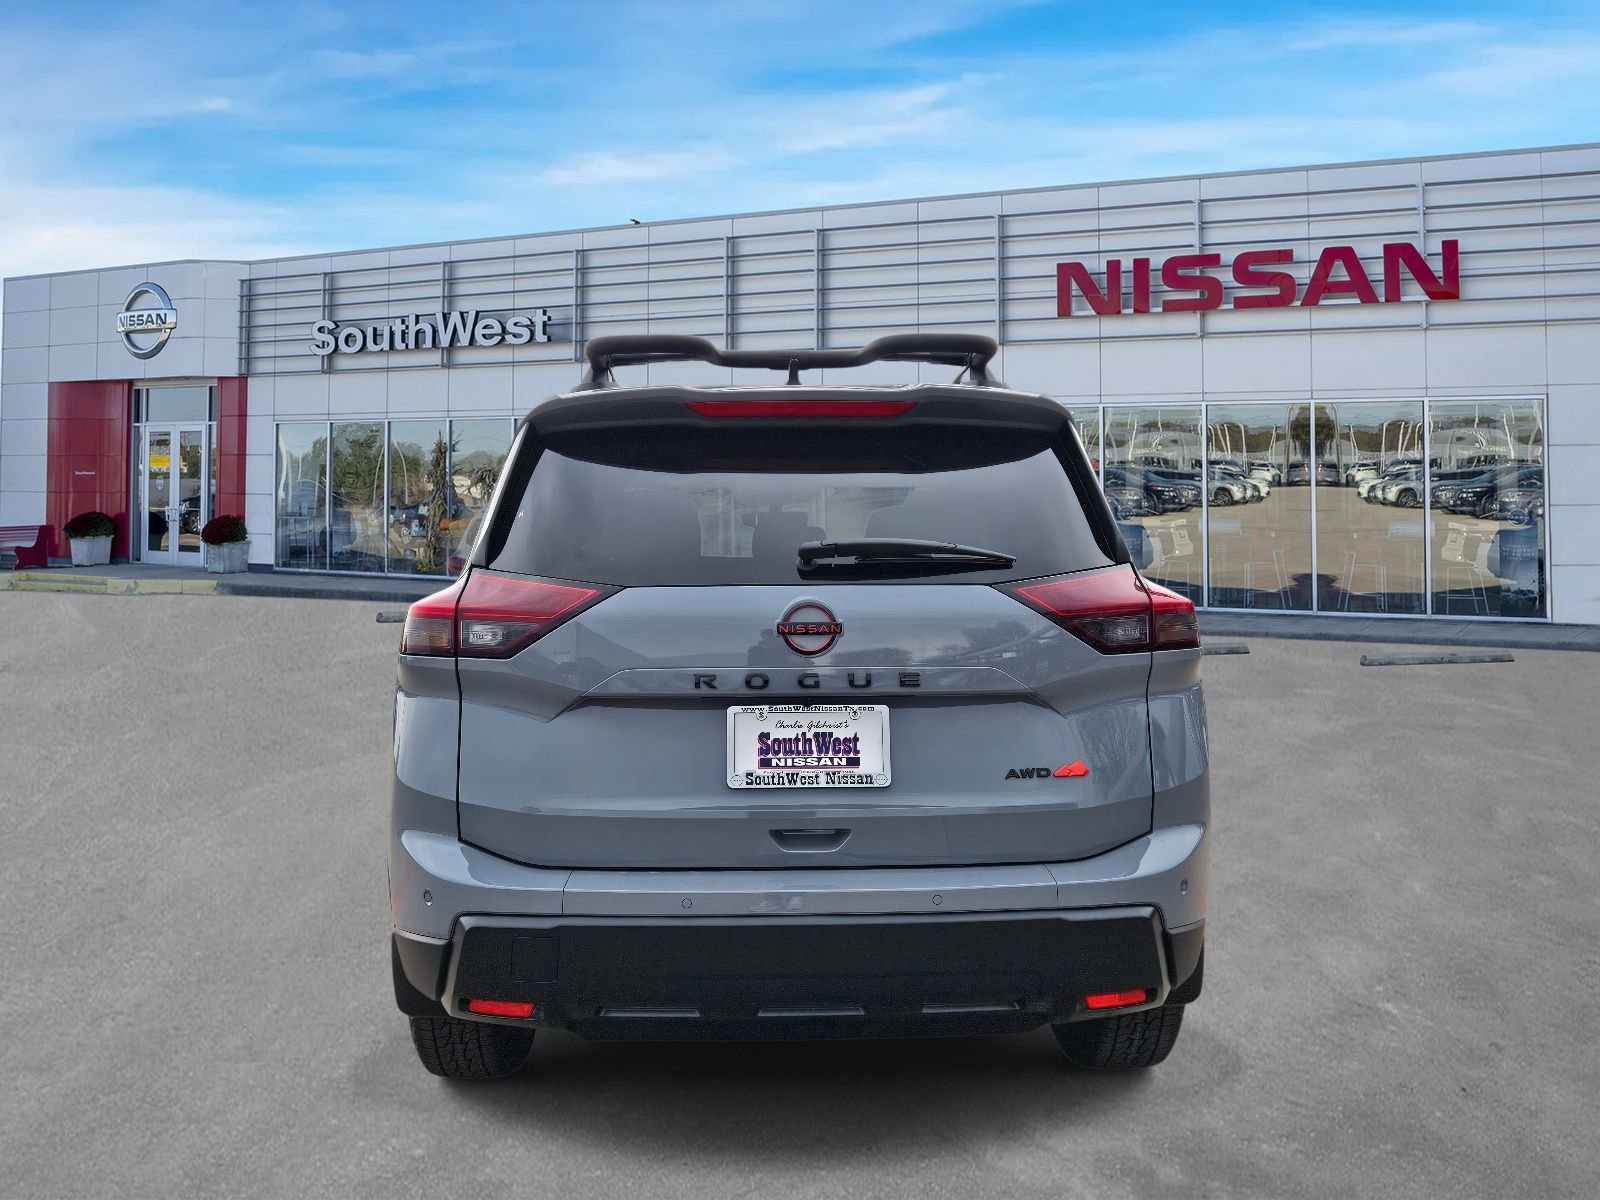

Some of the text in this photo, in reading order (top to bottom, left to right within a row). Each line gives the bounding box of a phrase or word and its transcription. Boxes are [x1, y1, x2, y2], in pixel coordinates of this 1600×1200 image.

[1057, 239, 1460, 317] NISSAN
[119, 312, 168, 328] NISSAN
[310, 308, 552, 356] SouthWest
[778, 623, 842, 634] NISSAN
[693, 672, 921, 690] ROGUE
[775, 719, 804, 729] Charlie
[757, 731, 861, 757] SouthWest
[771, 757, 847, 767] NISSAN
[745, 772, 875, 786] SouthWest Nissan
[1004, 767, 1052, 780] AWD
